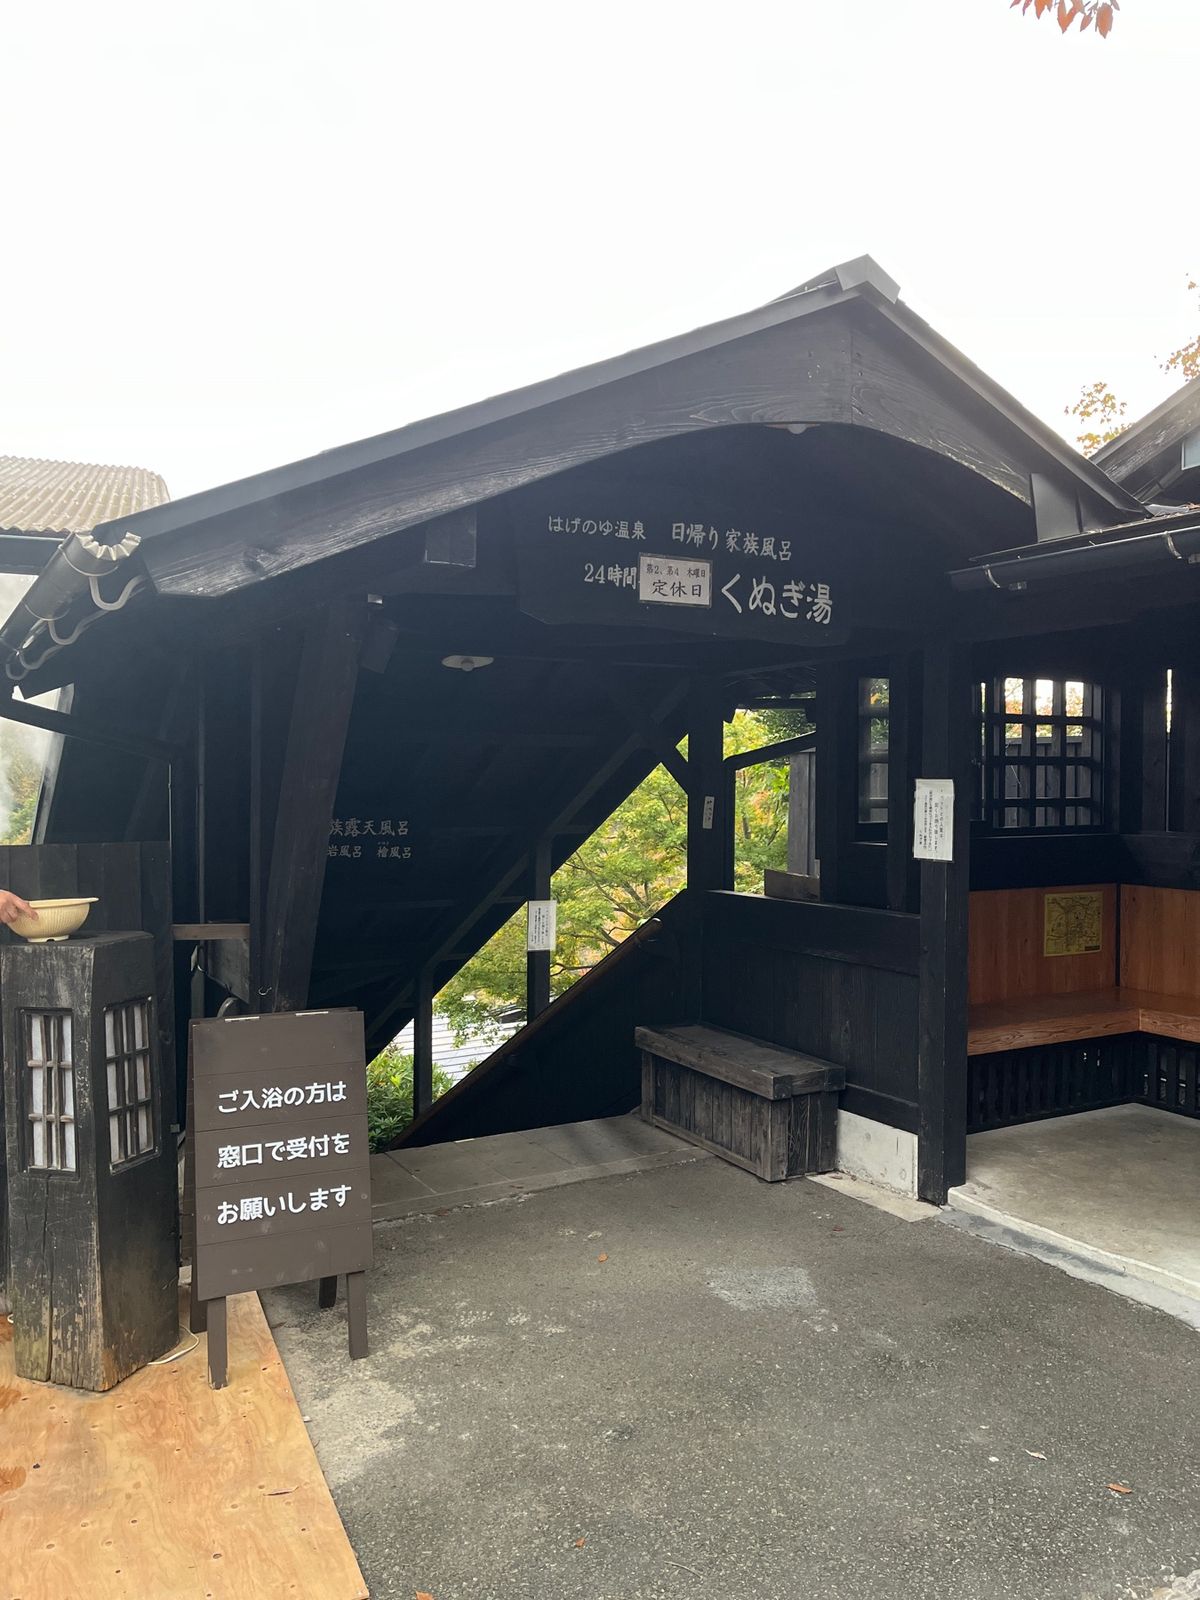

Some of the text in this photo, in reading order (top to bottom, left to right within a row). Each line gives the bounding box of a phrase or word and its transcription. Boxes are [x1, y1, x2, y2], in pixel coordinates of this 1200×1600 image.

[548, 515, 646, 541] はげのゆ温泉
[651, 579, 702, 598] 定休日
[687, 567, 706, 579] 木曜日
[721, 573, 832, 625] くぬぎ湯
[218, 1081, 347, 1113] ご入浴の方は
[217, 1132, 350, 1169] 窓口で受付を
[217, 1184, 352, 1225] お願いします
